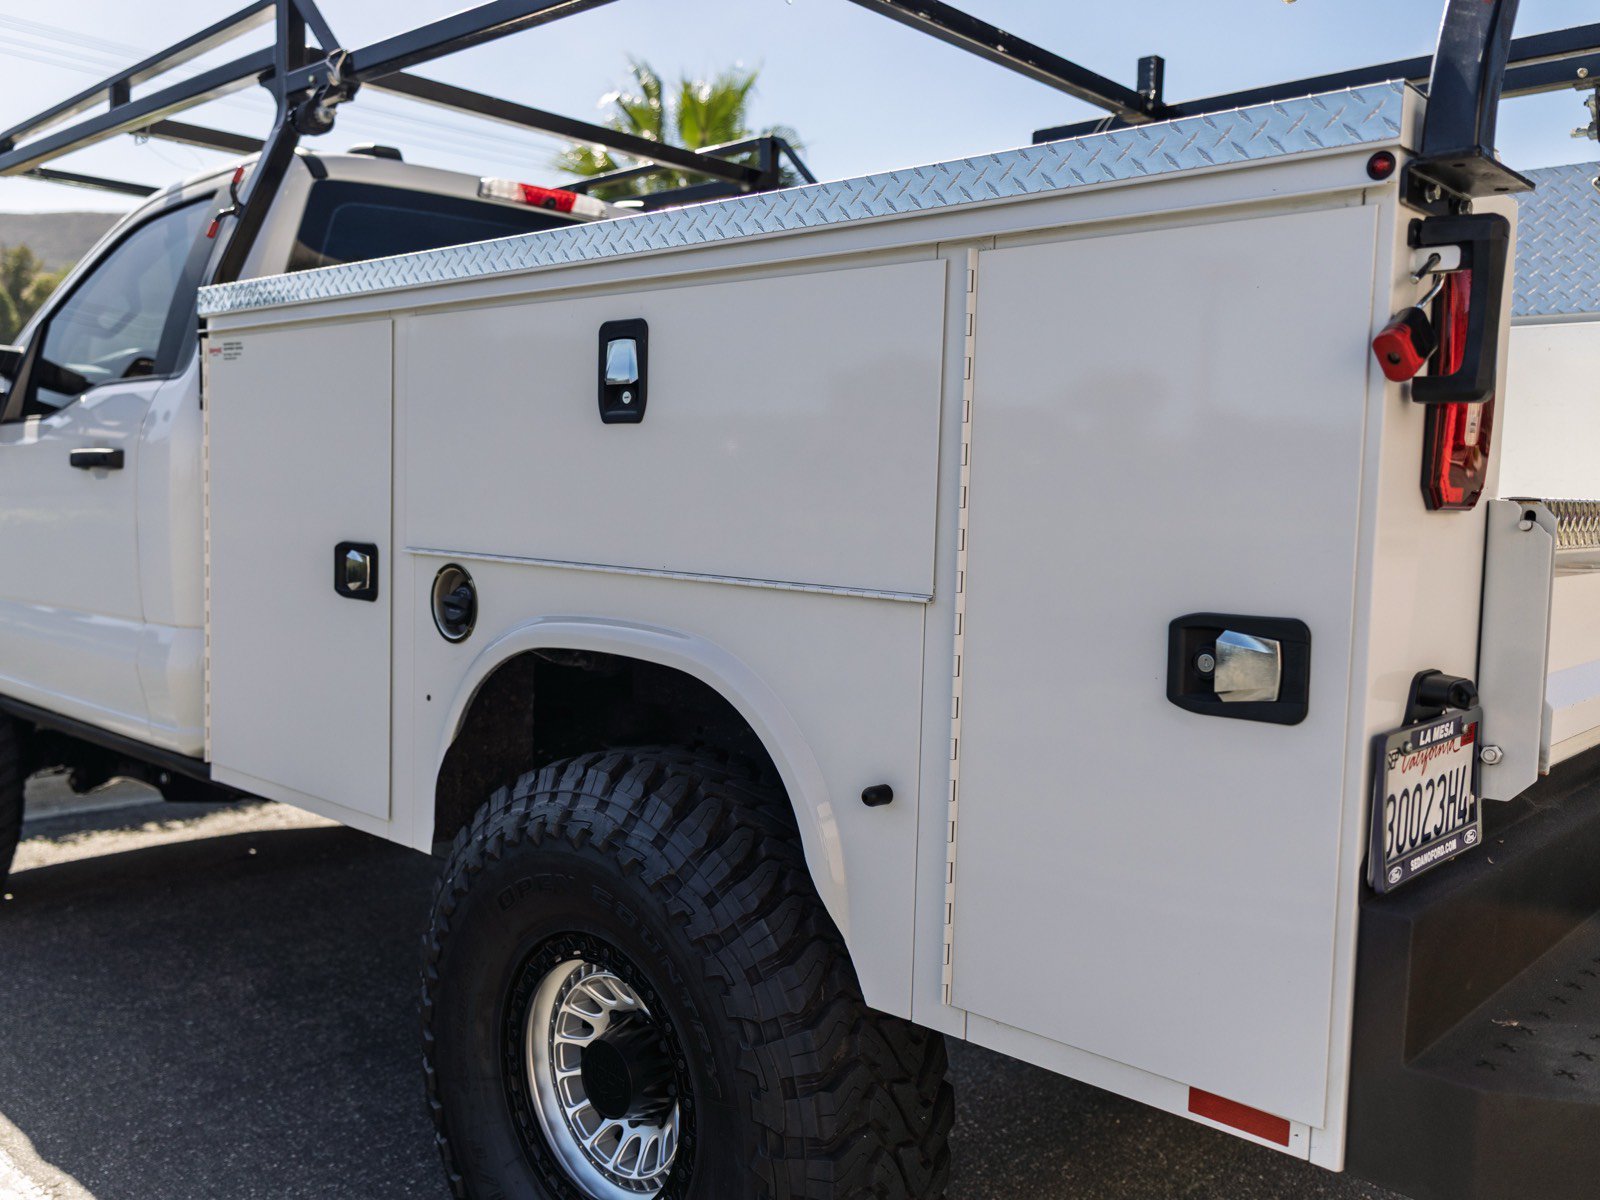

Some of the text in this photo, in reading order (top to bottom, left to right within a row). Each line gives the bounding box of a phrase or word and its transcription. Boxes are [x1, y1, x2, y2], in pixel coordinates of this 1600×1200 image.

[1419, 729, 1431, 746] LA
[1432, 721, 1454, 742] MESA
[1401, 737, 1460, 776] California
[1387, 765, 1468, 860] 30023H4
[498, 872, 577, 912] OPEN
